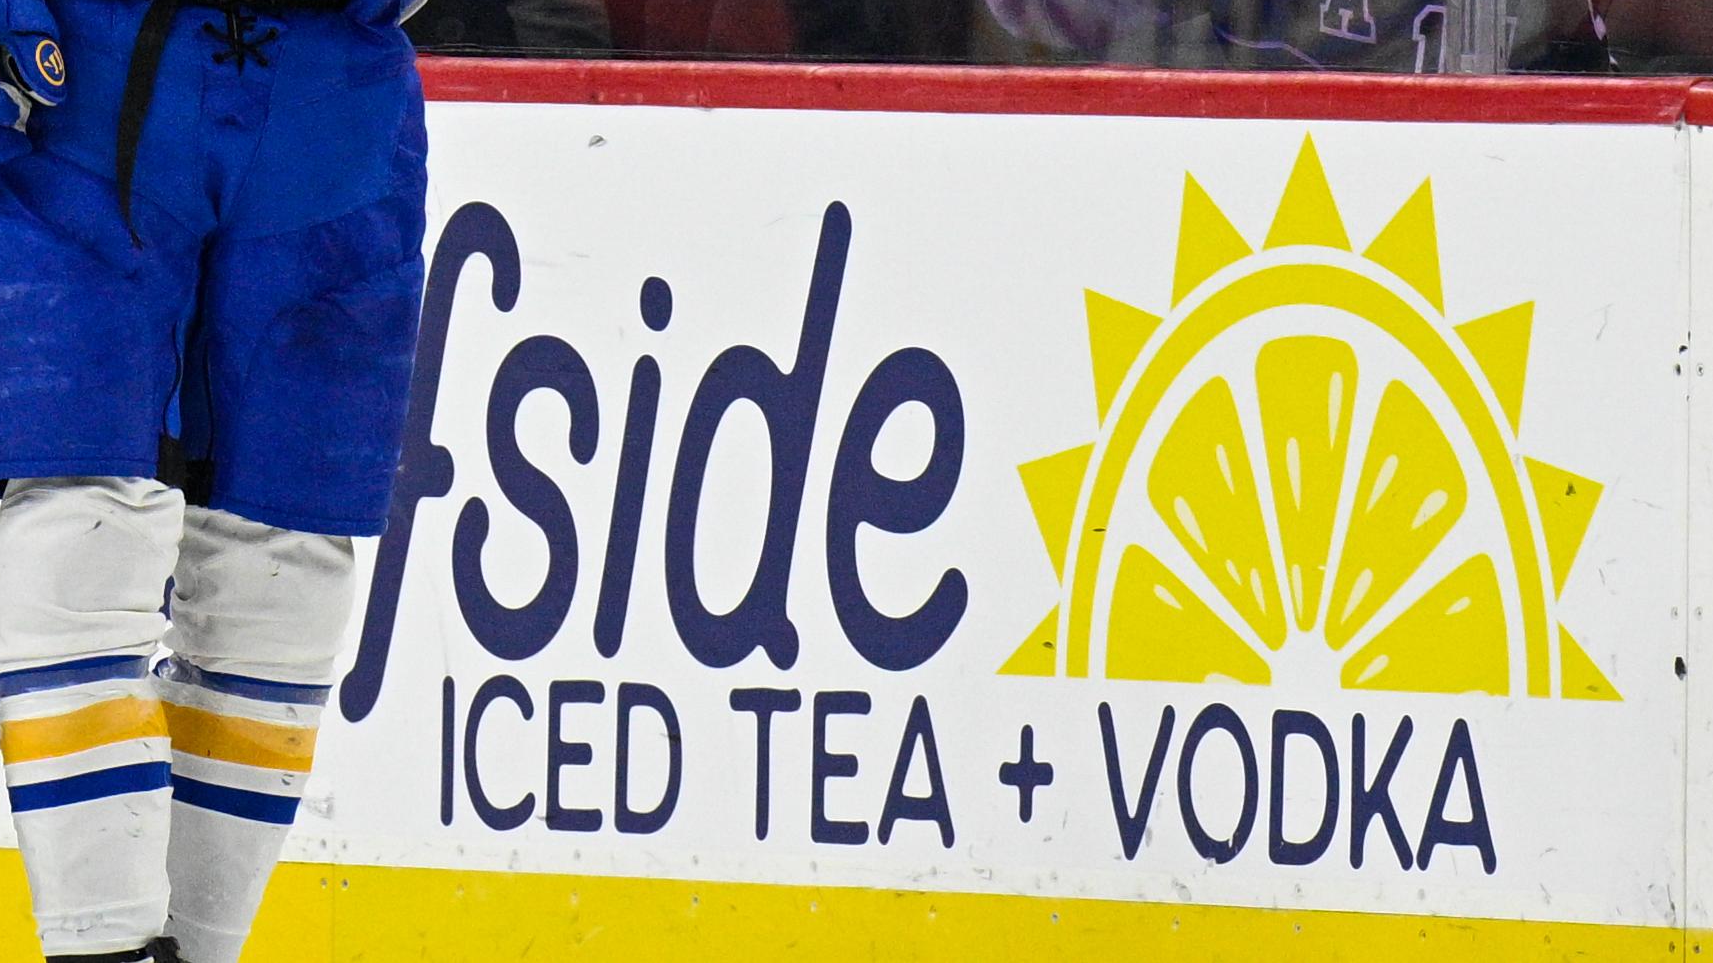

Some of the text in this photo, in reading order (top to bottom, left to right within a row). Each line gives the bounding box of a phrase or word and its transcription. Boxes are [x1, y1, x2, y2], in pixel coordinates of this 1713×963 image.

[440, 675, 1498, 876] ICED TEA + VODKA
